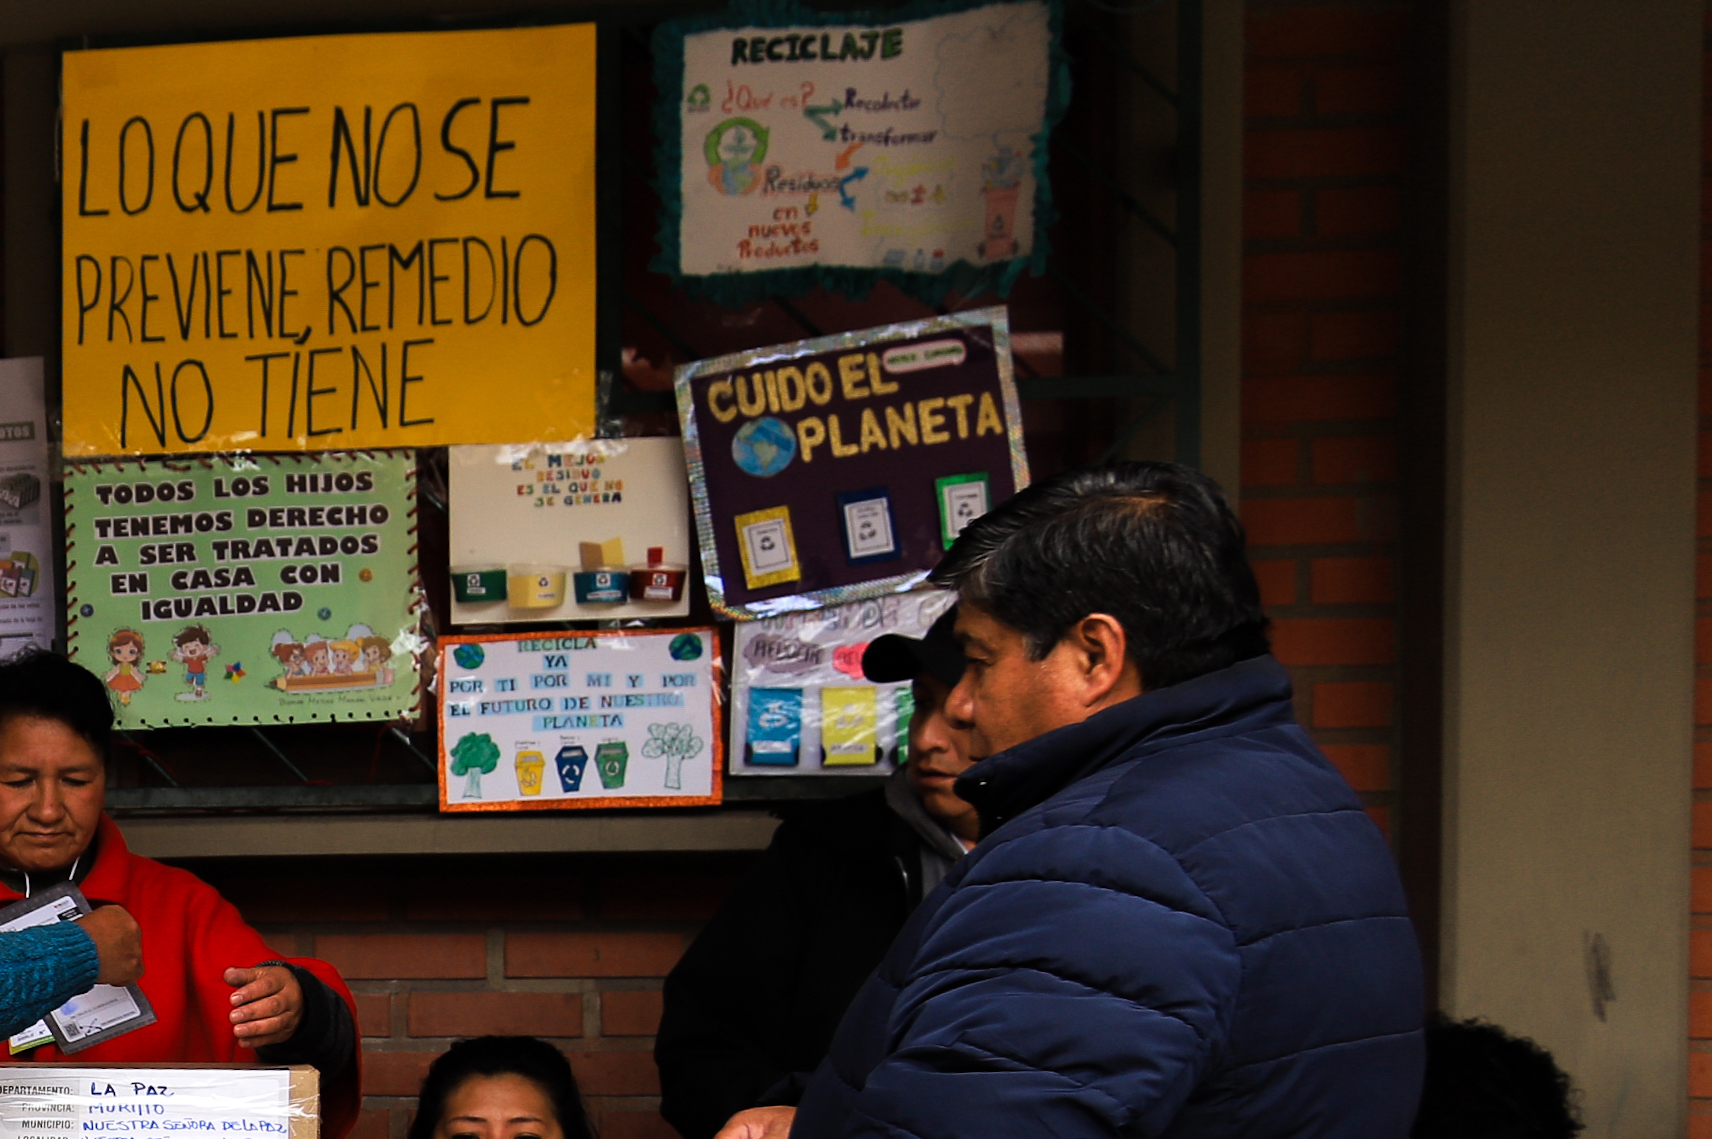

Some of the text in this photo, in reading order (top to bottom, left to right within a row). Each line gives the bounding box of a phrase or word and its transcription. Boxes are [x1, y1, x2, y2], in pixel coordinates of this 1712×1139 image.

[731, 27, 904, 65] RECICLAJE
[79, 96, 531, 217] LO QUE NO SE
[772, 206, 798, 221] en
[326, 233, 558, 335] REMEDIO
[120, 358, 214, 449] NO
[707, 352, 900, 424] CUIDO EL
[796, 391, 1004, 463] PLANETA
[95, 471, 374, 506] TODOS LOS HIJOS
[94, 504, 389, 539] TENEMOS DERECHO
[94, 534, 379, 566] A SER TRATADOS
[111, 563, 341, 595] EN CASA CON
[141, 591, 303, 622] IGUALDAD
[517, 637, 597, 653] RECICLA
[544, 655, 568, 668] YA
[449, 672, 696, 693] POR TI POR MI Y POR
[450, 705, 471, 717] EL
[480, 698, 552, 714] FUTURO
[563, 696, 590, 710] DE
[542, 714, 624, 729] PLANETA
[90, 1081, 117, 1097] LA
[131, 1082, 175, 1098] PAZ
[21, 1120, 75, 1130] MUNICIPIO:
[82, 1119, 159, 1131] NUESTRA
[162, 1117, 217, 1131] SEÑORA
